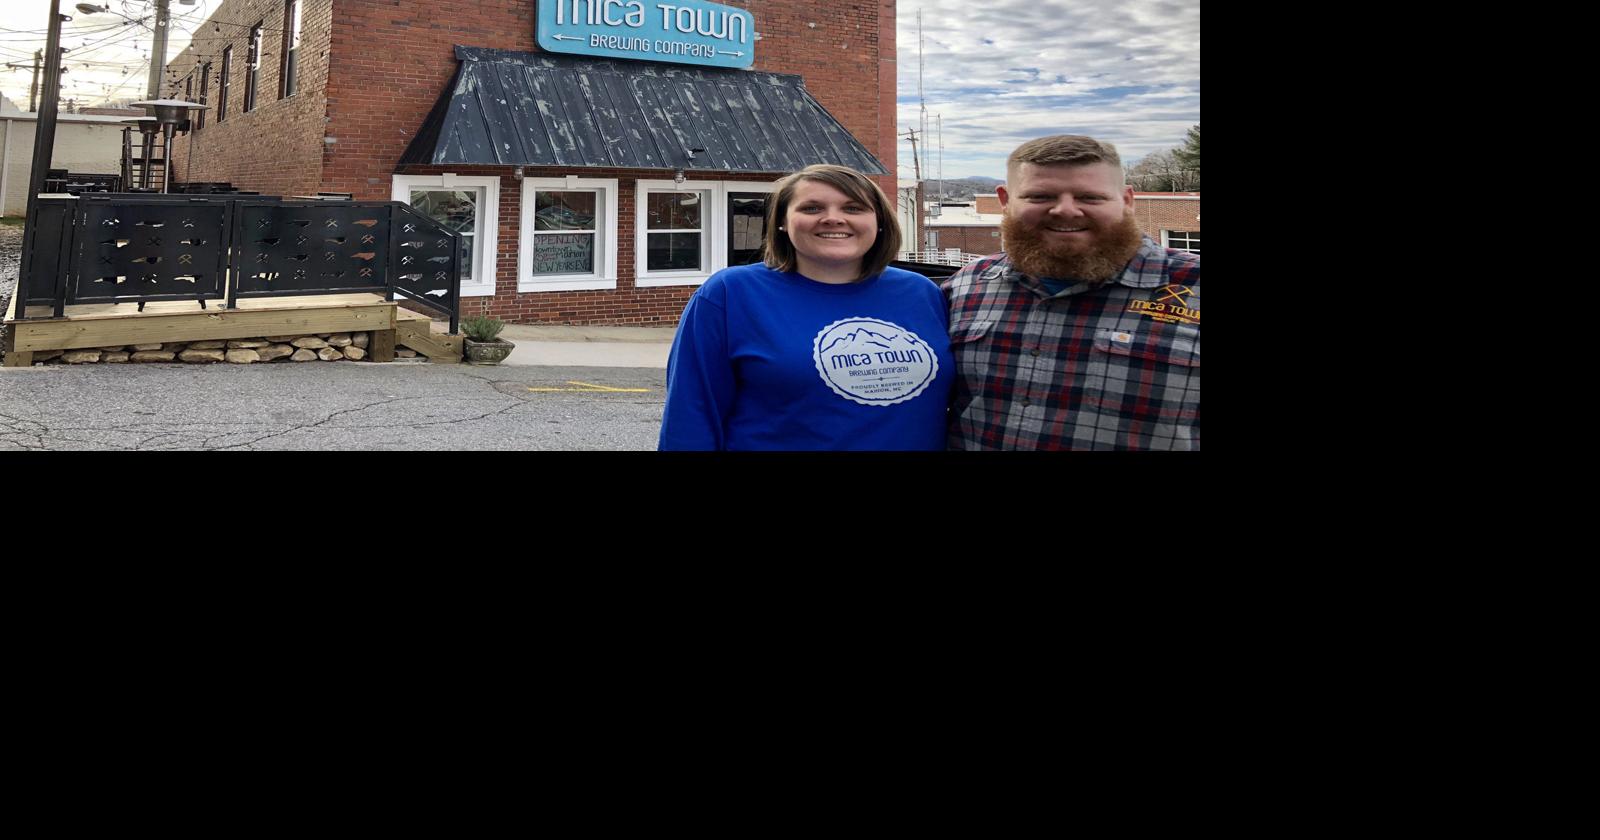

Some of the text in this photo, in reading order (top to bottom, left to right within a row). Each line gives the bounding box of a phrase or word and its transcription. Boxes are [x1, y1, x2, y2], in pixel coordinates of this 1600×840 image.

[657, 3, 746, 44] TOWN
[590, 33, 716, 58] BREWING COMPANY
[831, 349, 924, 370] MICA TOWN
[848, 365, 909, 377] BREWING COMPANY
